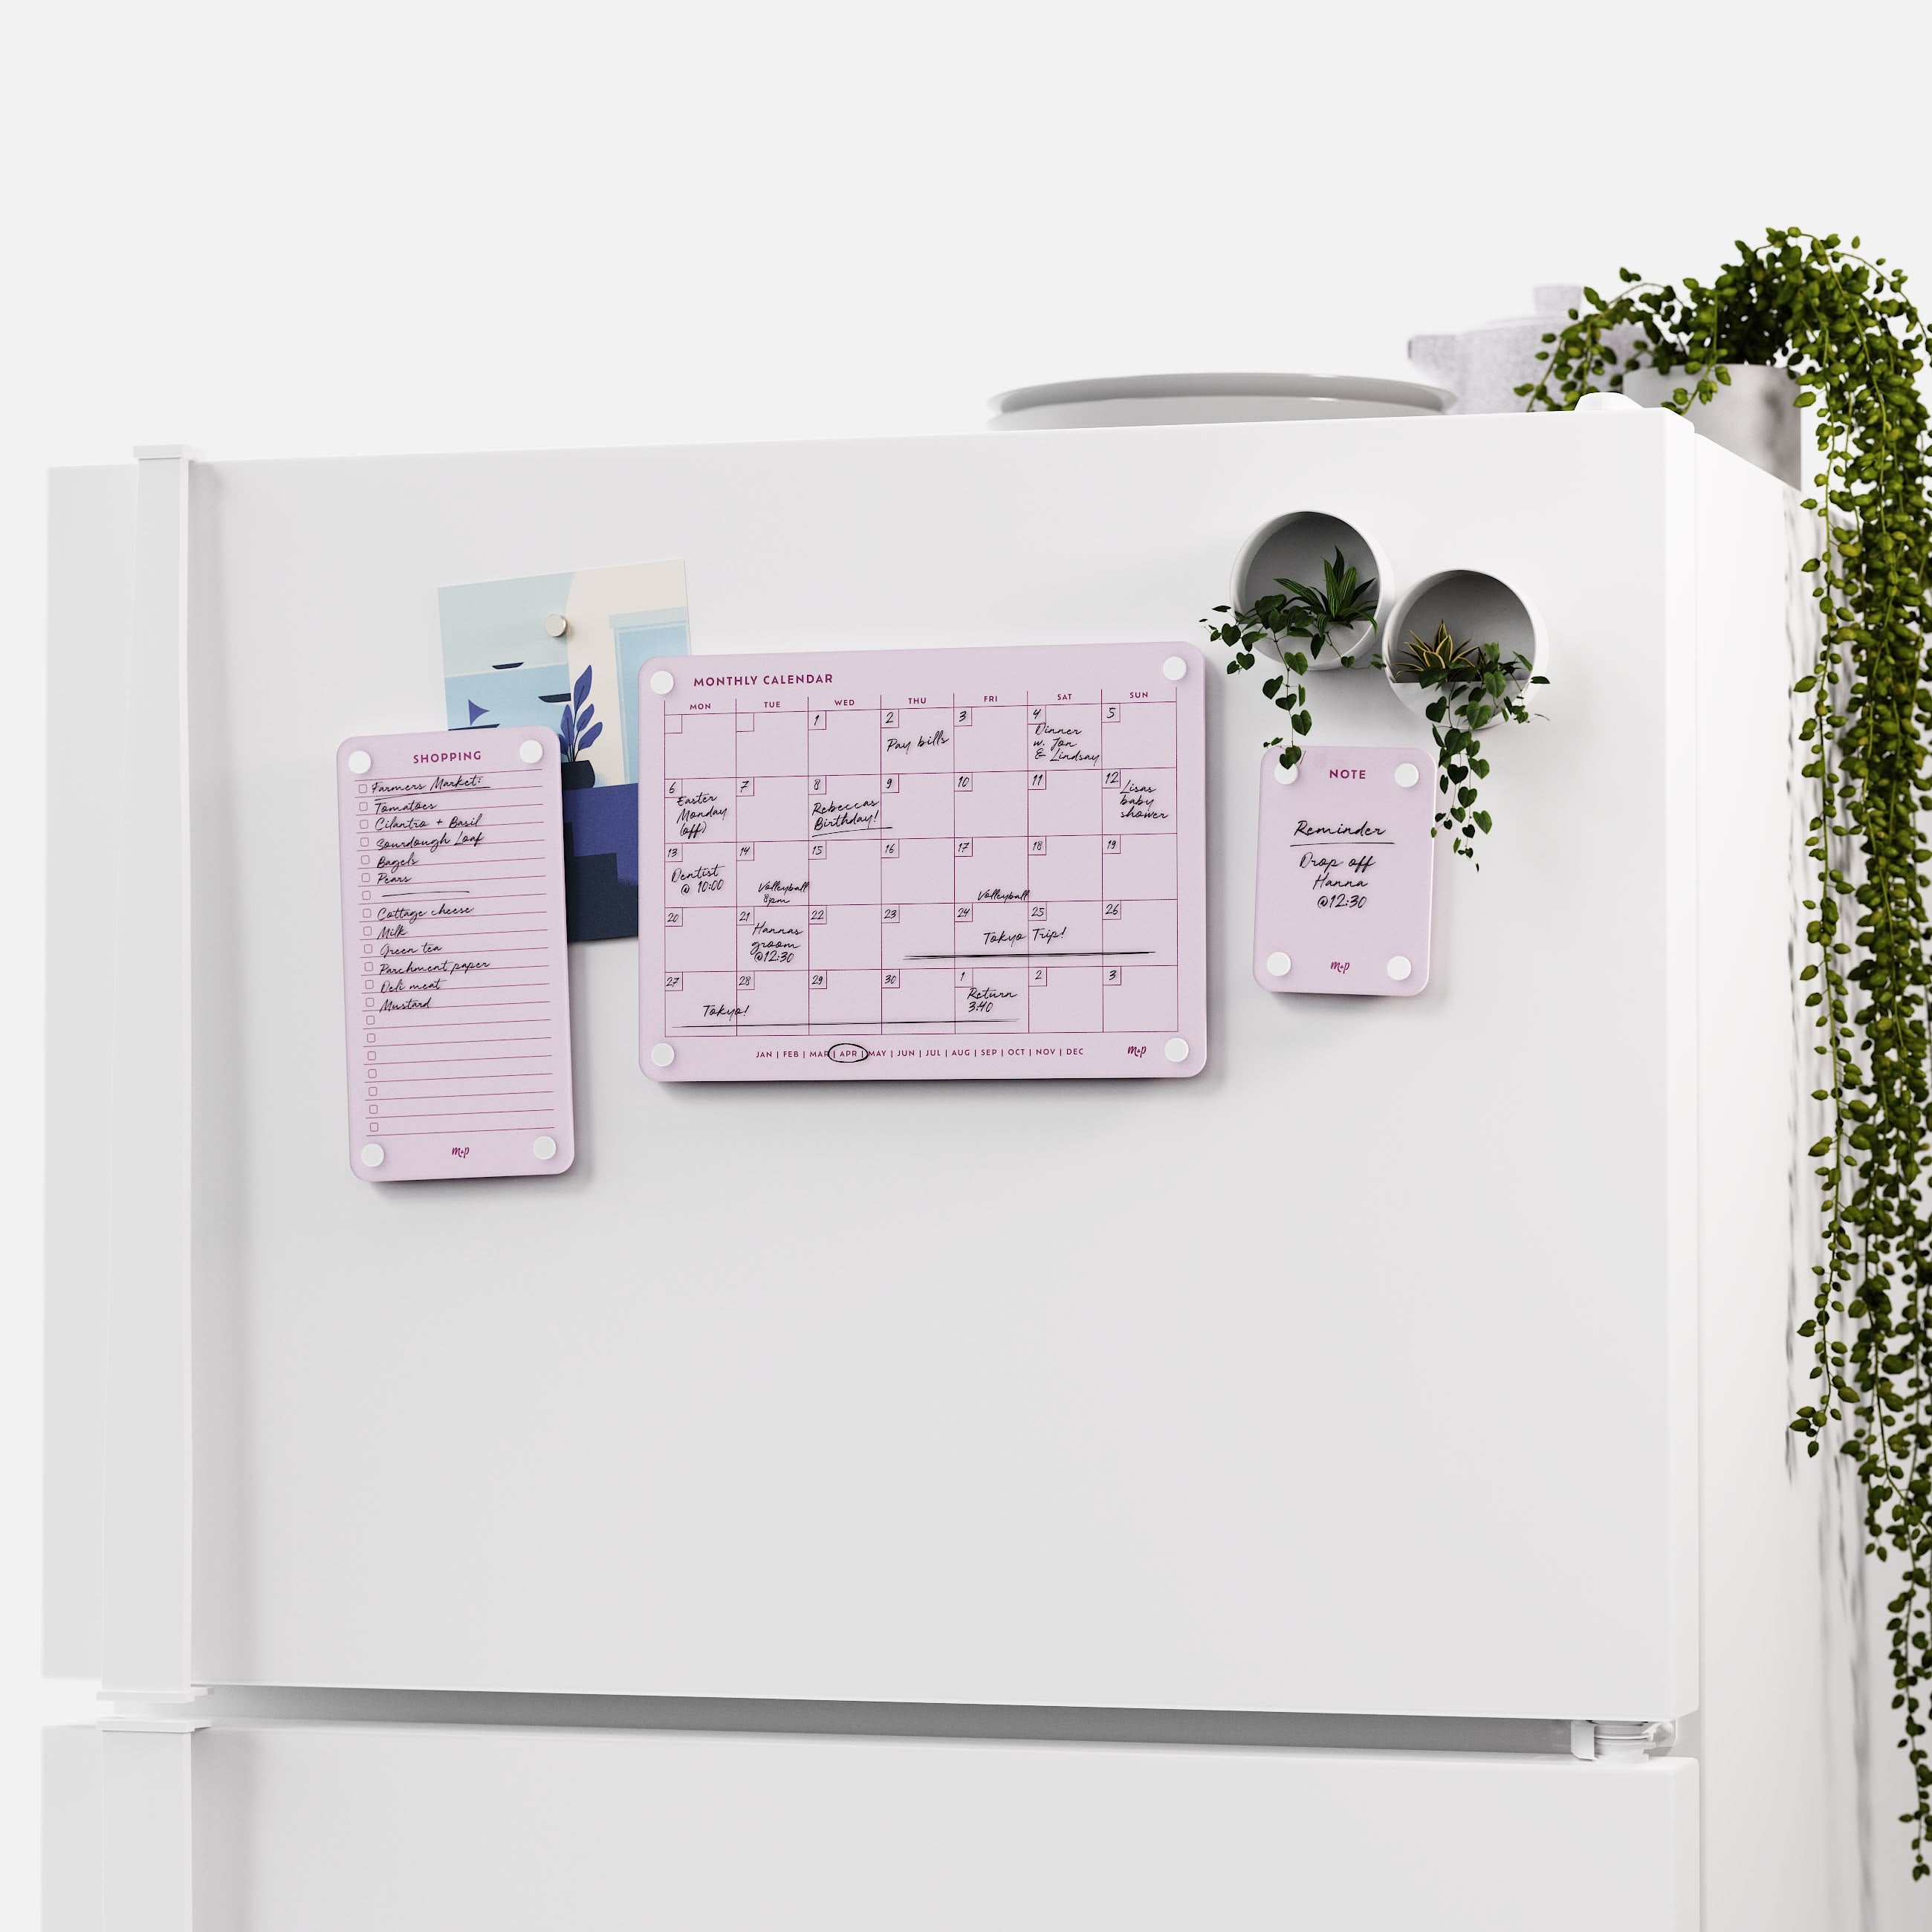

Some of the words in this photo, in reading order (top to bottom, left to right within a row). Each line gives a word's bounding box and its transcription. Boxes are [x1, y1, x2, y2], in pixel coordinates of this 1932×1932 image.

[693, 675, 759, 687] MONTHLY
[763, 674, 833, 685] CALENDAR
[885, 712, 894, 724] 2
[959, 710, 967, 722] 3
[1033, 708, 1041, 719] 4
[1107, 707, 1115, 719] 5
[814, 715, 820, 726] 1
[1034, 722, 1083, 735] Dinner
[887, 738, 911, 755] Pay
[917, 731, 950, 747] bills
[1051, 737, 1077, 750] Jon
[413, 751, 482, 764] SHOPPING
[1049, 748, 1100, 766] Lindsay
[1031, 774, 1043, 786] 11
[1104, 771, 1119, 785] 12
[1329, 770, 1366, 779] NOTE
[372, 782, 427, 794] Farmers
[429, 775, 482, 791] Market:
[740, 781, 749, 791] 7
[814, 779, 820, 791] 8
[886, 779, 892, 789] 9
[958, 776, 969, 787] 10
[1120, 779, 1156, 794] Lisas
[670, 782, 675, 794] 6
[677, 791, 717, 806] Easter
[1120, 795, 1154, 811] baby
[375, 802, 438, 814] Tomatoes
[811, 800, 879, 816] Rebeccas
[1121, 808, 1169, 819] shower
[676, 806, 728, 823] Monday
[375, 817, 429, 831] Cilantro
[449, 814, 484, 828] Basil
[814, 811, 878, 831] Birthday!
[679, 822, 707, 839] (off)
[1294, 820, 1386, 836] Reminder
[376, 832, 450, 852] Sourdough
[453, 832, 484, 846] Loaf
[958, 841, 969, 853] 17
[1033, 840, 1042, 852] 18
[1106, 839, 1116, 850] 19
[667, 847, 677, 858] 13
[740, 846, 750, 857] 14
[811, 846, 823, 856] 15
[884, 843, 894, 854] 16
[377, 852, 420, 873] Bagels
[1300, 852, 1343, 872] Drop
[1349, 855, 1376, 872] off
[377, 873, 412, 884] Pears
[672, 863, 725, 884] Dentist
[681, 884, 690, 894] @
[698, 879, 724, 893] 10:00
[1313, 872, 1368, 890] Hanna
[757, 881, 811, 896] Volleyball
[764, 893, 790, 906] 8pm
[977, 889, 1031, 903] Volleyball
[1317, 893, 1367, 909] @12:30
[377, 907, 427, 924] Cottage
[432, 904, 475, 915] cheese
[811, 910, 824, 921] 22
[884, 908, 897, 919] 23
[958, 907, 970, 918] 24
[1031, 906, 1045, 917] 25
[1105, 904, 1118, 915] 26
[667, 912, 679, 923] 20
[739, 911, 750, 922] 21
[377, 926, 408, 940] Milk
[752, 921, 804, 936] Hannas
[982, 931, 1028, 947] Tokyo
[1032, 927, 1067, 944] Trip!
[380, 944, 418, 958] Green
[421, 943, 442, 952] tea
[750, 941, 801, 955] groom
[753, 950, 794, 963] @12:30
[380, 960, 453, 975] Parchment
[450, 961, 490, 974] paper
[739, 975, 750, 987] 28
[811, 974, 823, 985] 29
[884, 973, 896, 984] 30
[959, 971, 965, 982] 1
[1034, 970, 1042, 980] 2
[1109, 970, 1116, 980] 3
[380, 979, 406, 993] Deli
[409, 979, 447, 990] meat
[666, 976, 680, 988] 27
[967, 987, 1017, 999] Return
[380, 997, 432, 1012] Mustard
[968, 1001, 993, 1013] 3:40
[702, 1005, 750, 1021] Tokyo!
